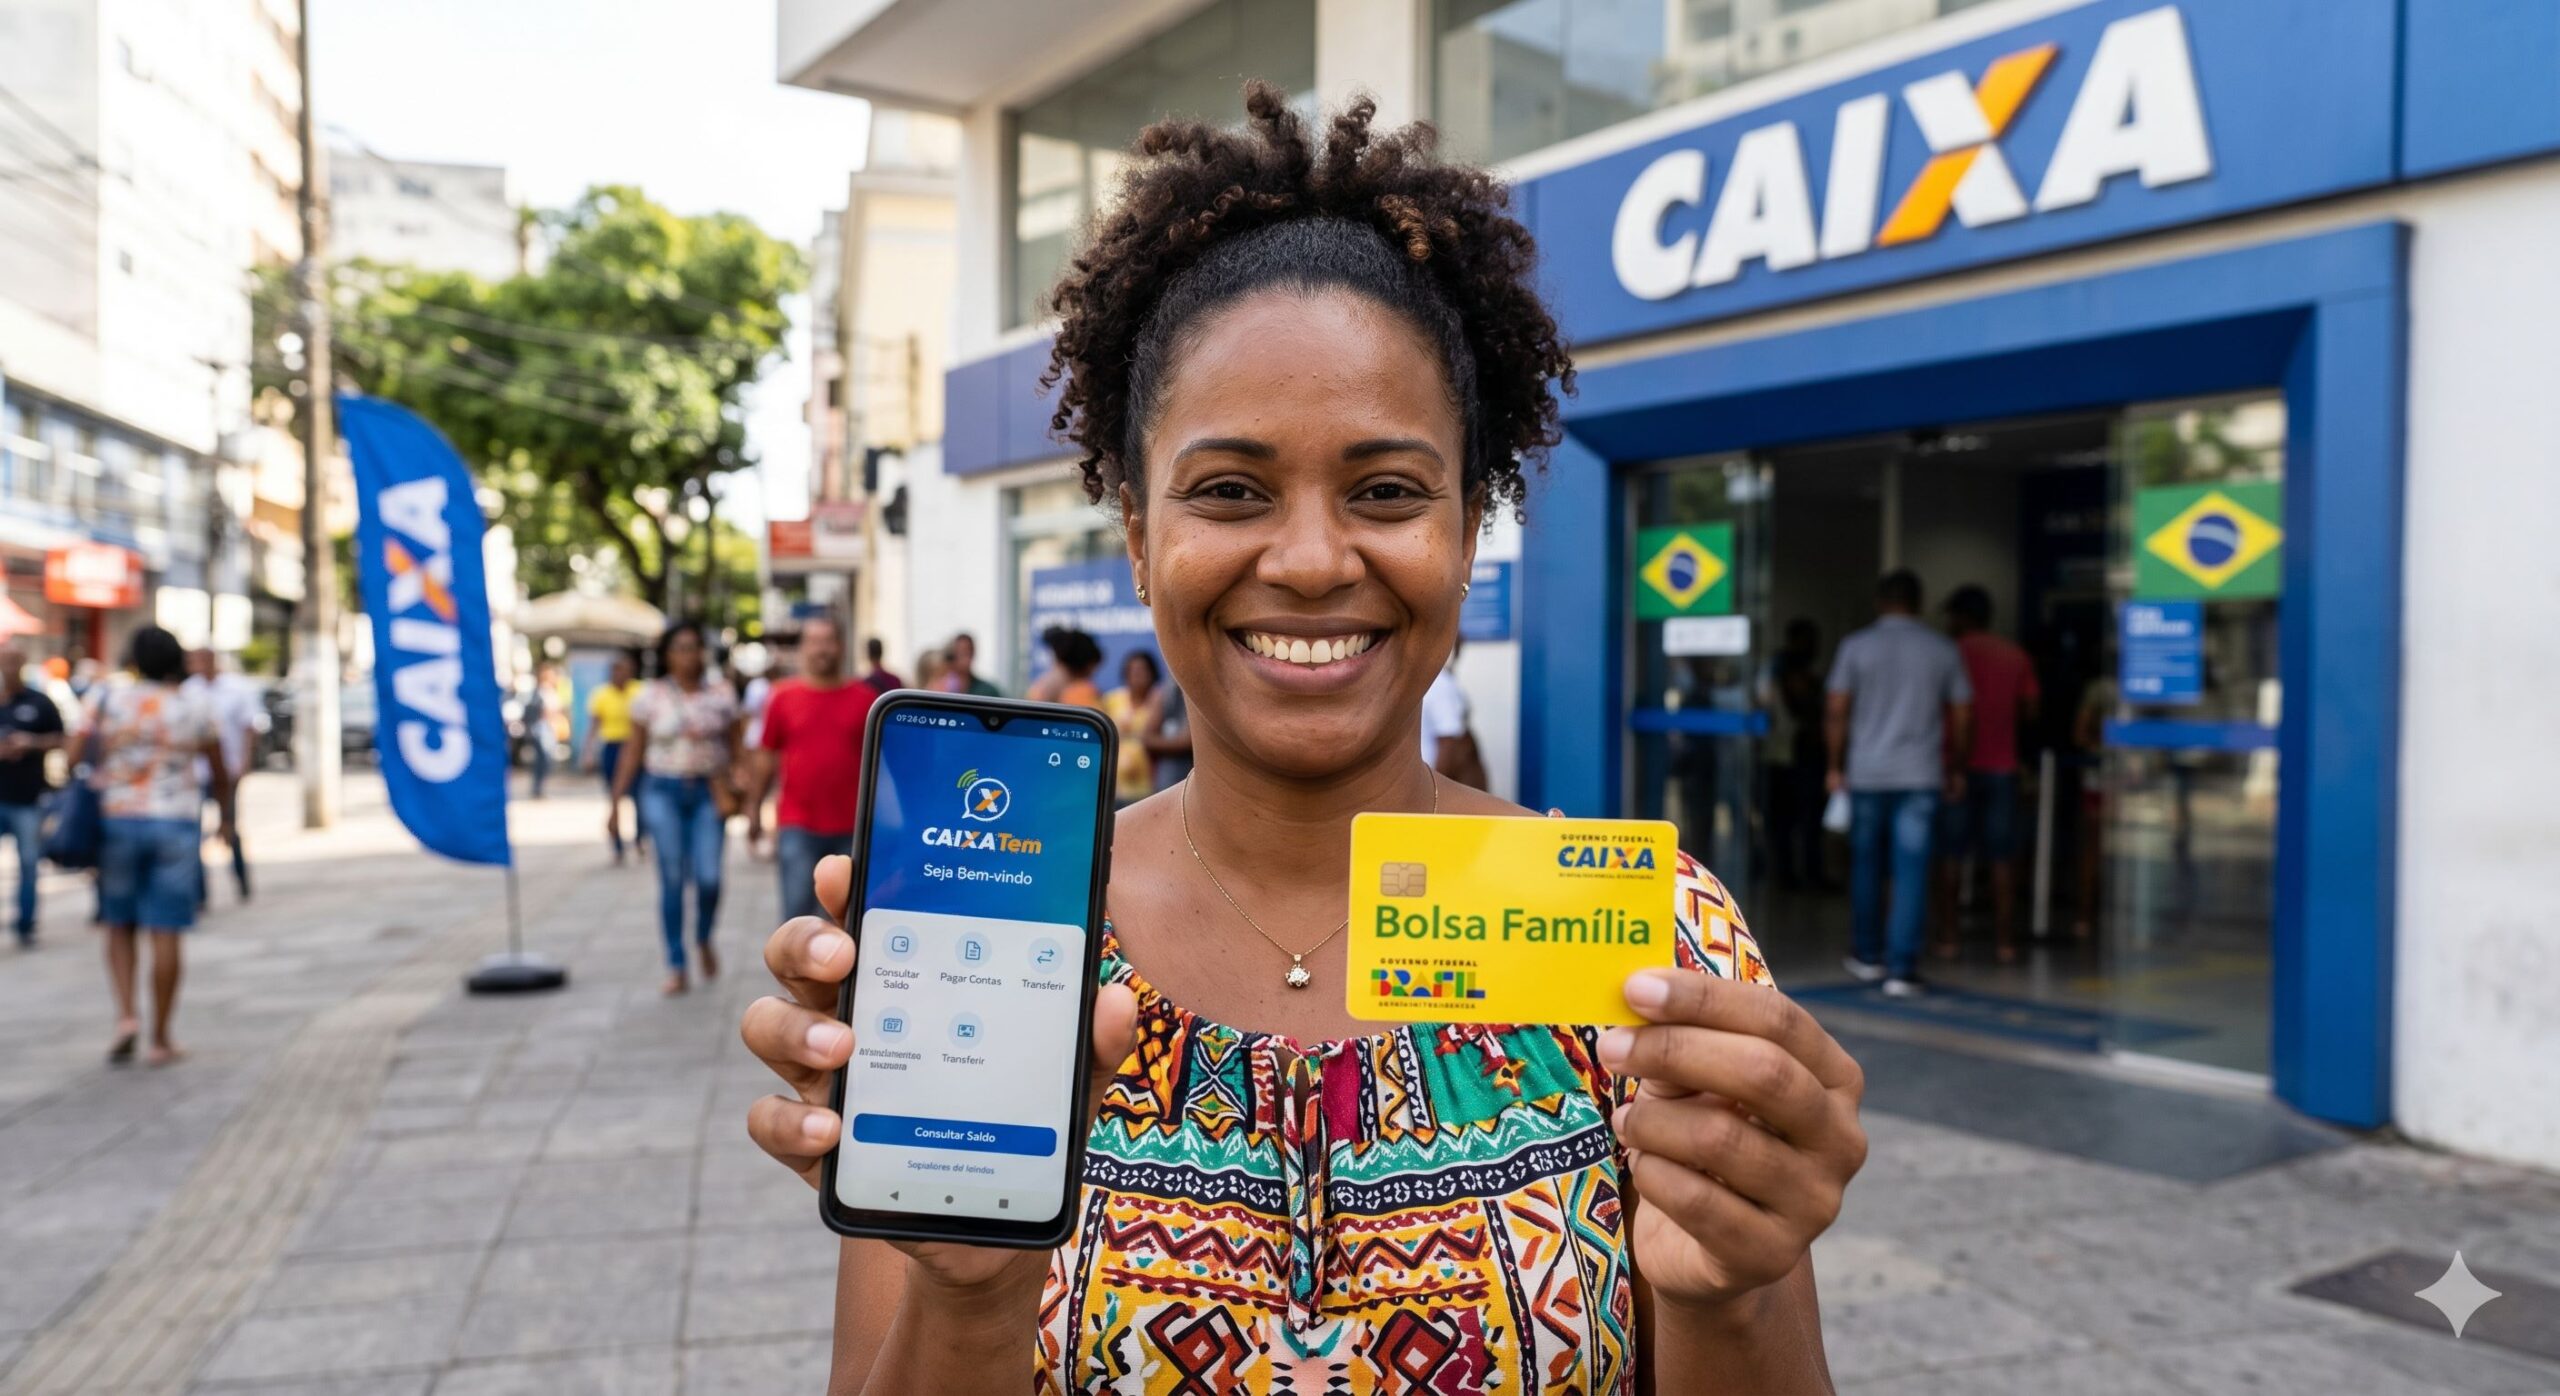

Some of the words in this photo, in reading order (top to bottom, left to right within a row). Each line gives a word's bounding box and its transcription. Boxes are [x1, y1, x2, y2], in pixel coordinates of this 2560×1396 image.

[1612, 4, 2213, 301] CAIXA
[377, 475, 473, 784] CAIXA
[1557, 845, 1656, 870] CAIXA
[923, 863, 953, 881] Seja
[957, 867, 1033, 886] Bem-vindo
[1375, 904, 1487, 941] Bolsa
[1502, 906, 1651, 946] Família
[874, 966, 920, 980] Consultar
[940, 972, 967, 985] Pagar
[968, 974, 1002, 986] Contas
[883, 979, 910, 991] Saldo
[1021, 978, 1066, 992] Transferir
[941, 1053, 986, 1066] Transferir
[914, 1126, 965, 1140] Consultar
[966, 1130, 996, 1143] Saldo
